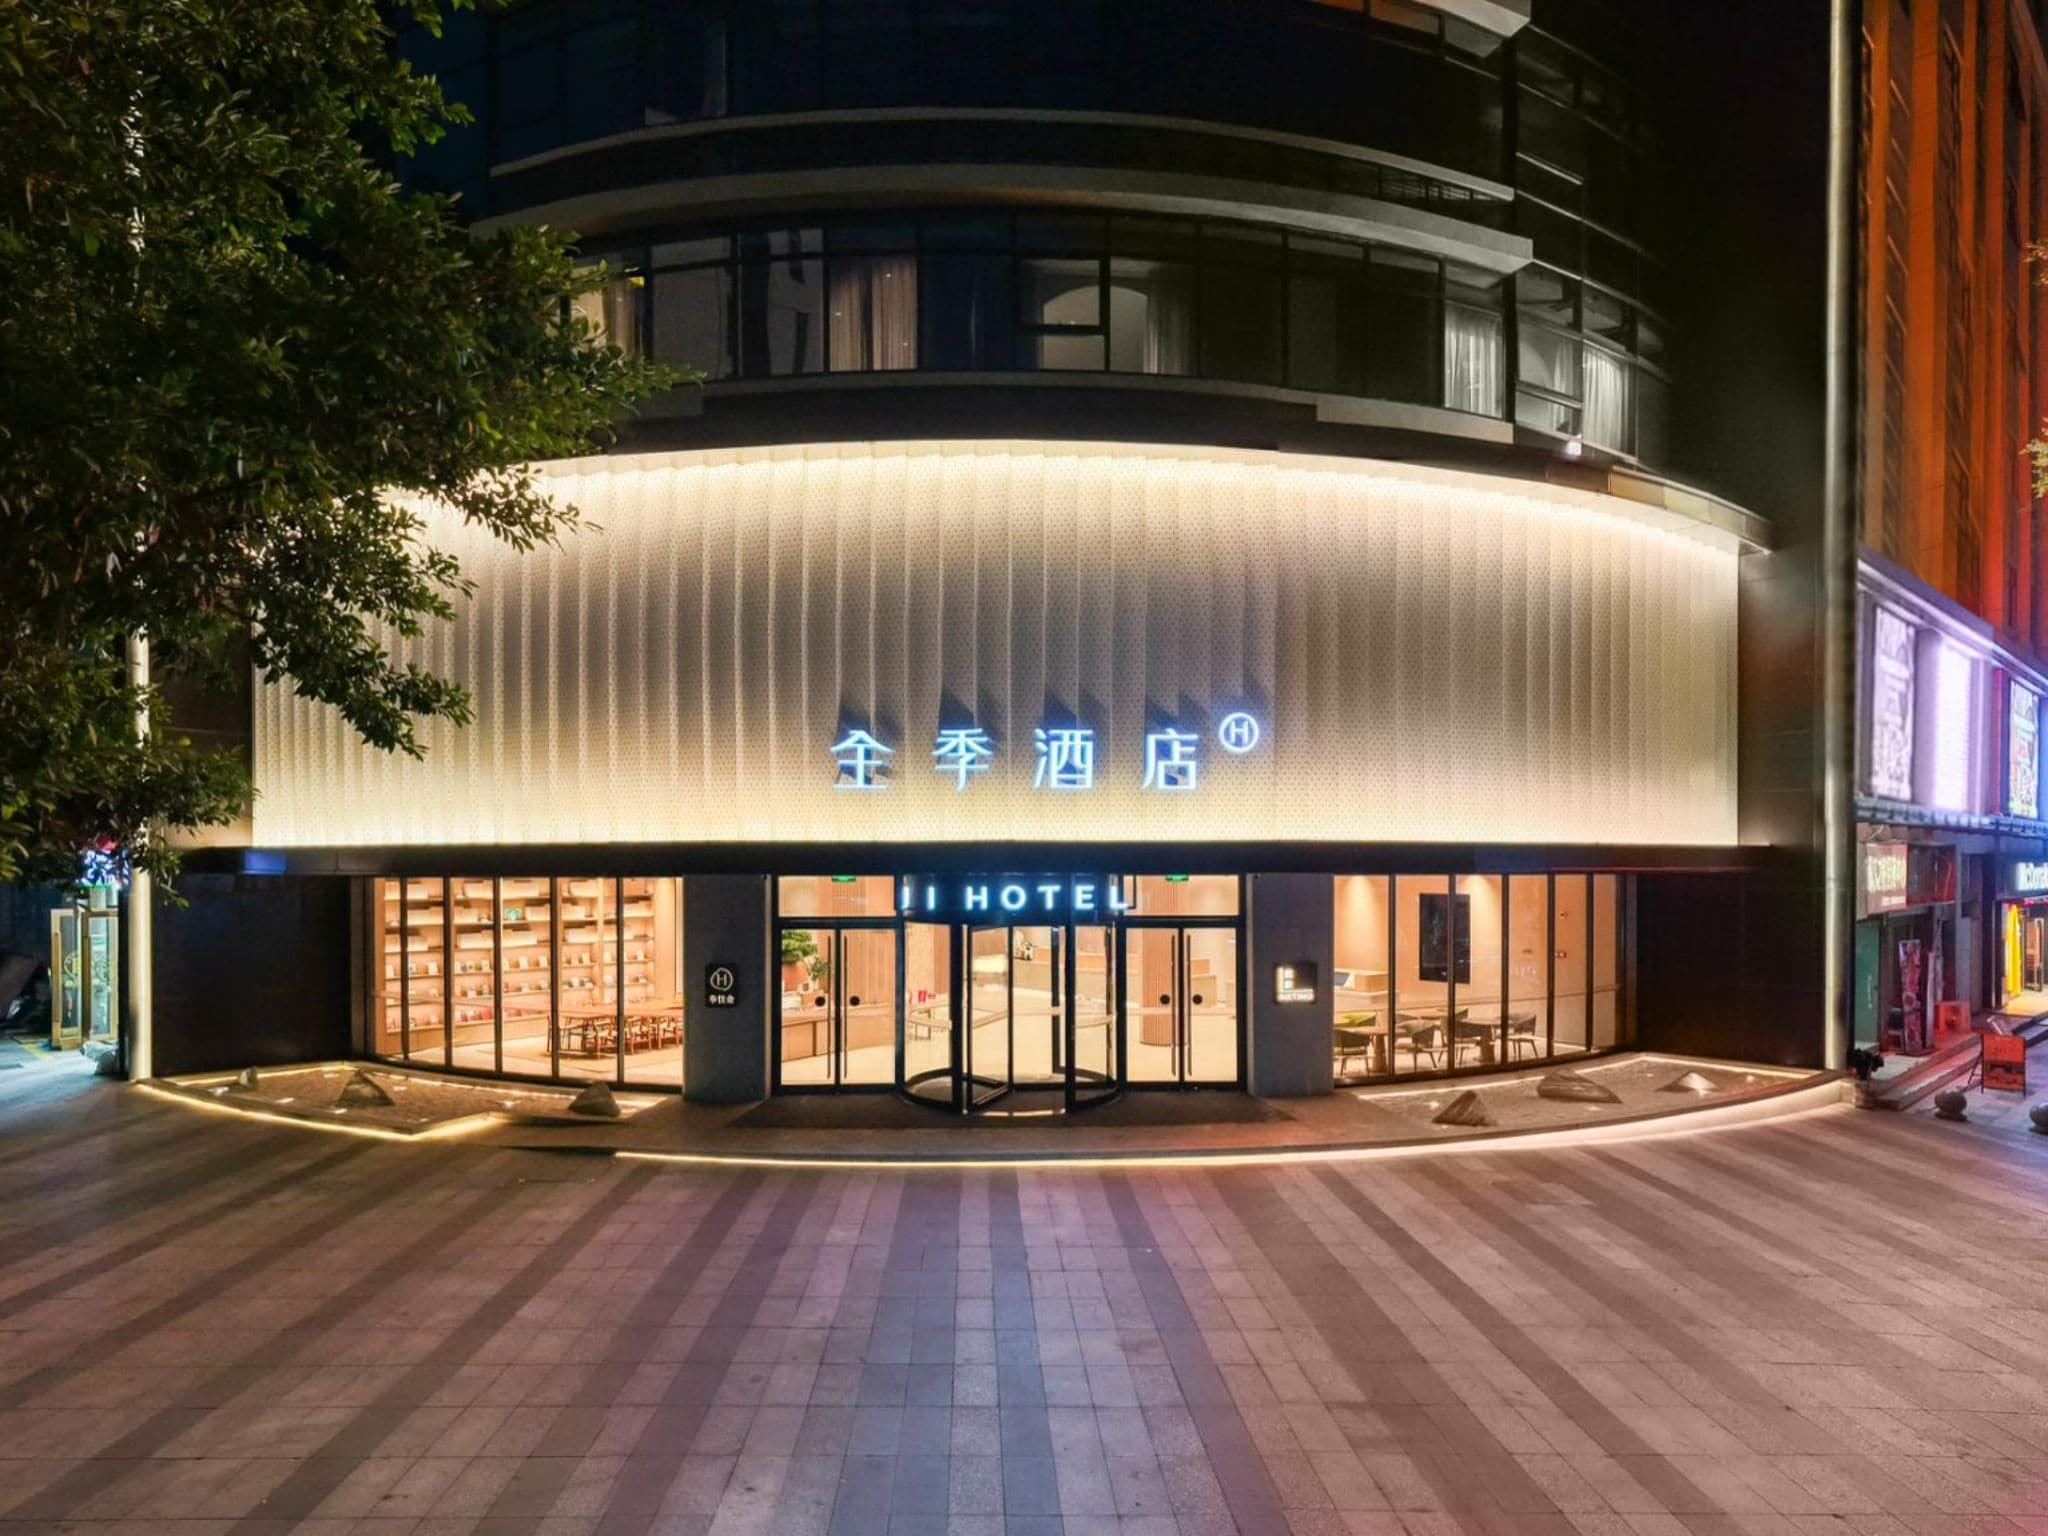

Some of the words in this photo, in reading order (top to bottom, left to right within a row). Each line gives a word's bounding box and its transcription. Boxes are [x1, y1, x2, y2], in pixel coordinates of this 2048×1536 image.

[830, 727, 1200, 791] 全季酒店
[965, 885, 1130, 911] HOTEL
